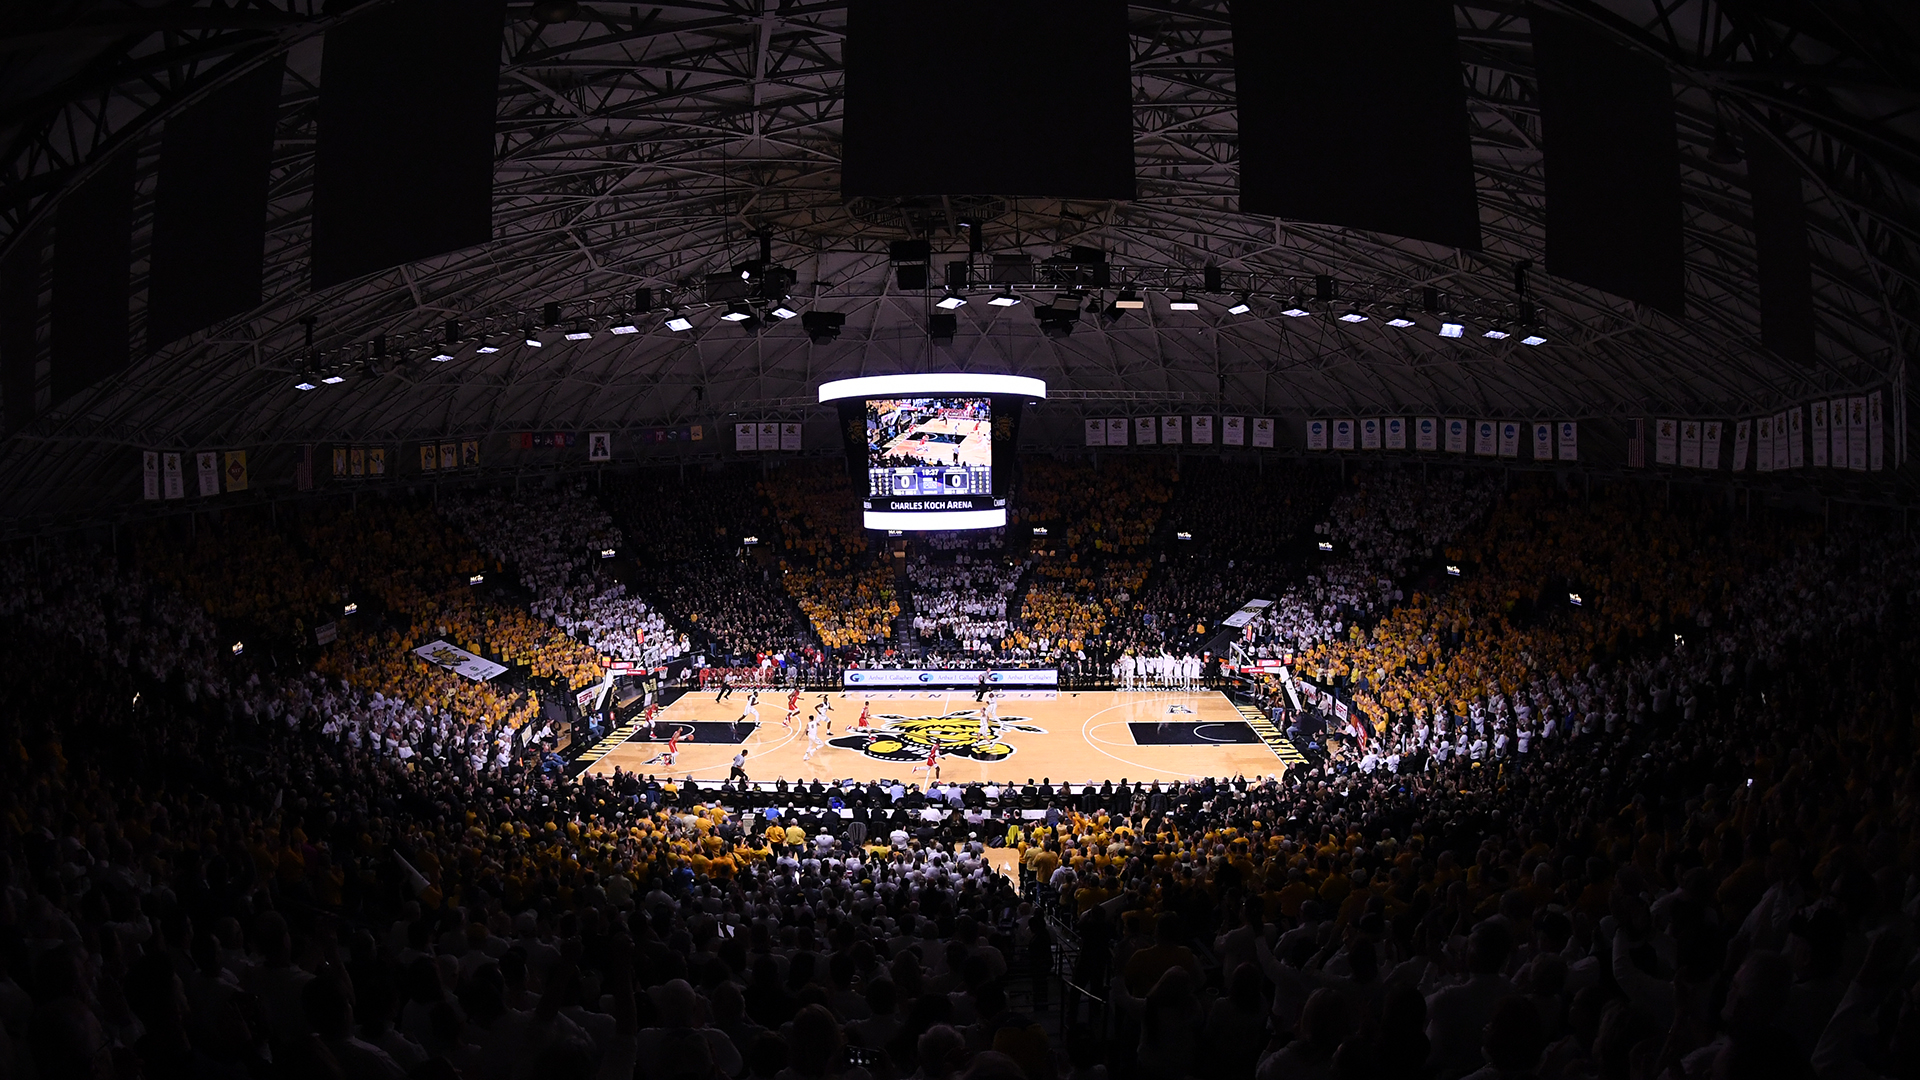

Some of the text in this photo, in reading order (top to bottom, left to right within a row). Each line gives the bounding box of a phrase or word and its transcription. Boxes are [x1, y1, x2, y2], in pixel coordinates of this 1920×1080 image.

[901, 475, 910, 488] 0
[951, 475, 961, 488] 0
[890, 500, 973, 510] CHARLES KOCH ARENA
